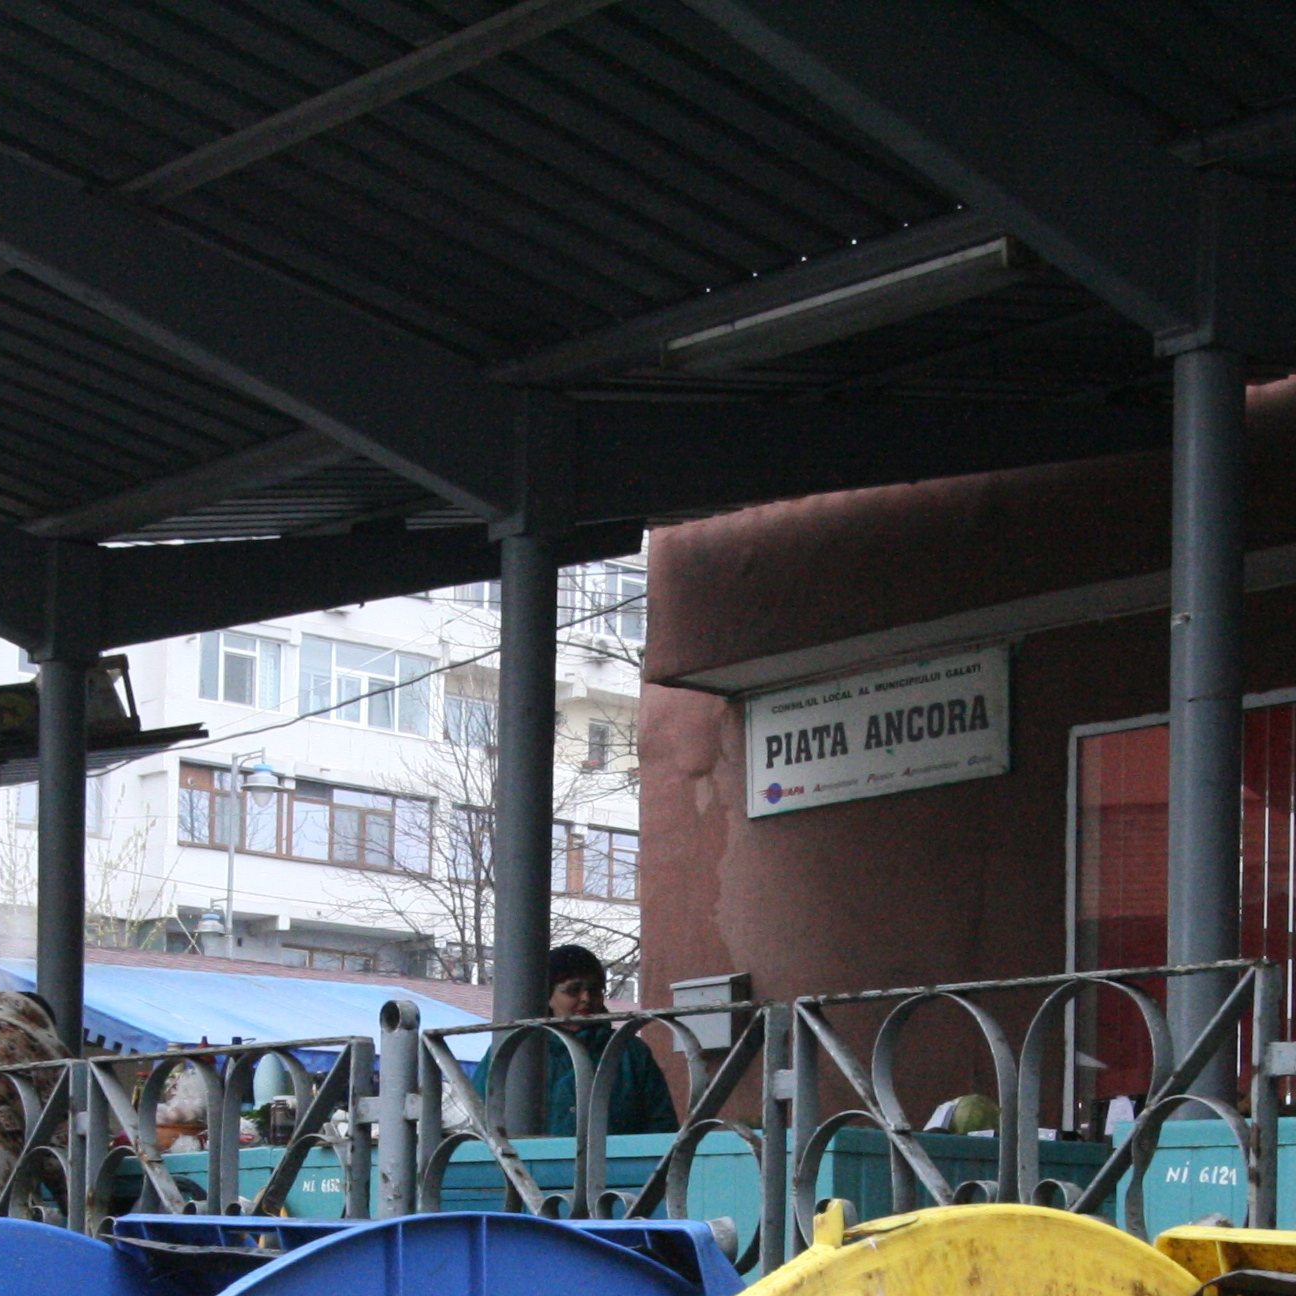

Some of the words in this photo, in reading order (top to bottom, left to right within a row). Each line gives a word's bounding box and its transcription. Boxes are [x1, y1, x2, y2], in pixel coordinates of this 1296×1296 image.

[771, 696, 819, 715] CONSILIUL
[823, 688, 853, 703] LOCAL
[858, 685, 871, 696] AL
[945, 663, 982, 679] GALATI
[765, 721, 849, 769] PIATA
[864, 693, 990, 750] ANCORA
